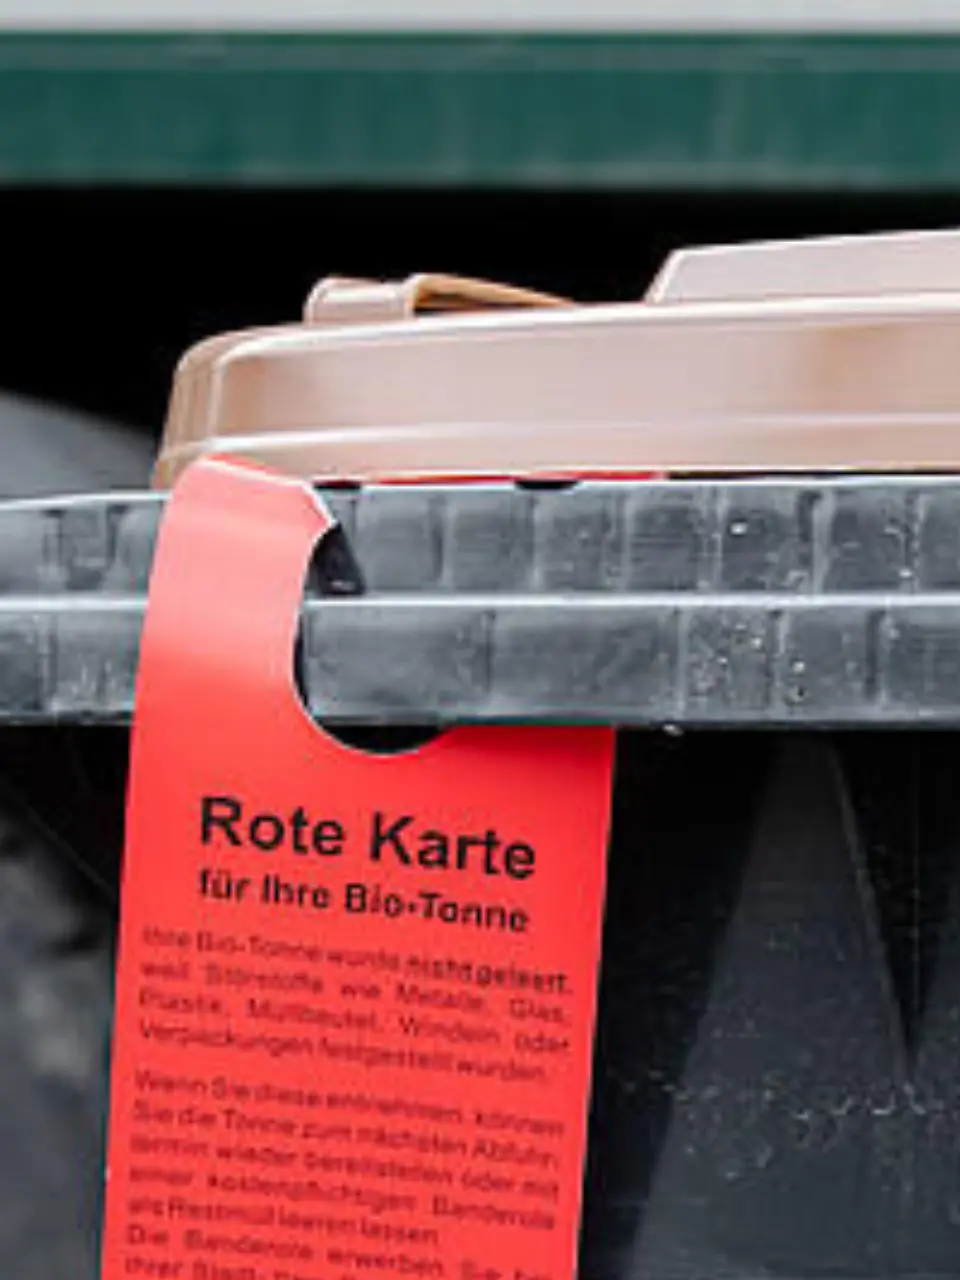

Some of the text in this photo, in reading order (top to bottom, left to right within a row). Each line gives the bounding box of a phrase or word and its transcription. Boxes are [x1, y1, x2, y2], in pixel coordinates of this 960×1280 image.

[202, 796, 536, 879] Rote Karte
[199, 869, 530, 934] für Ihre Bio-Tonne
